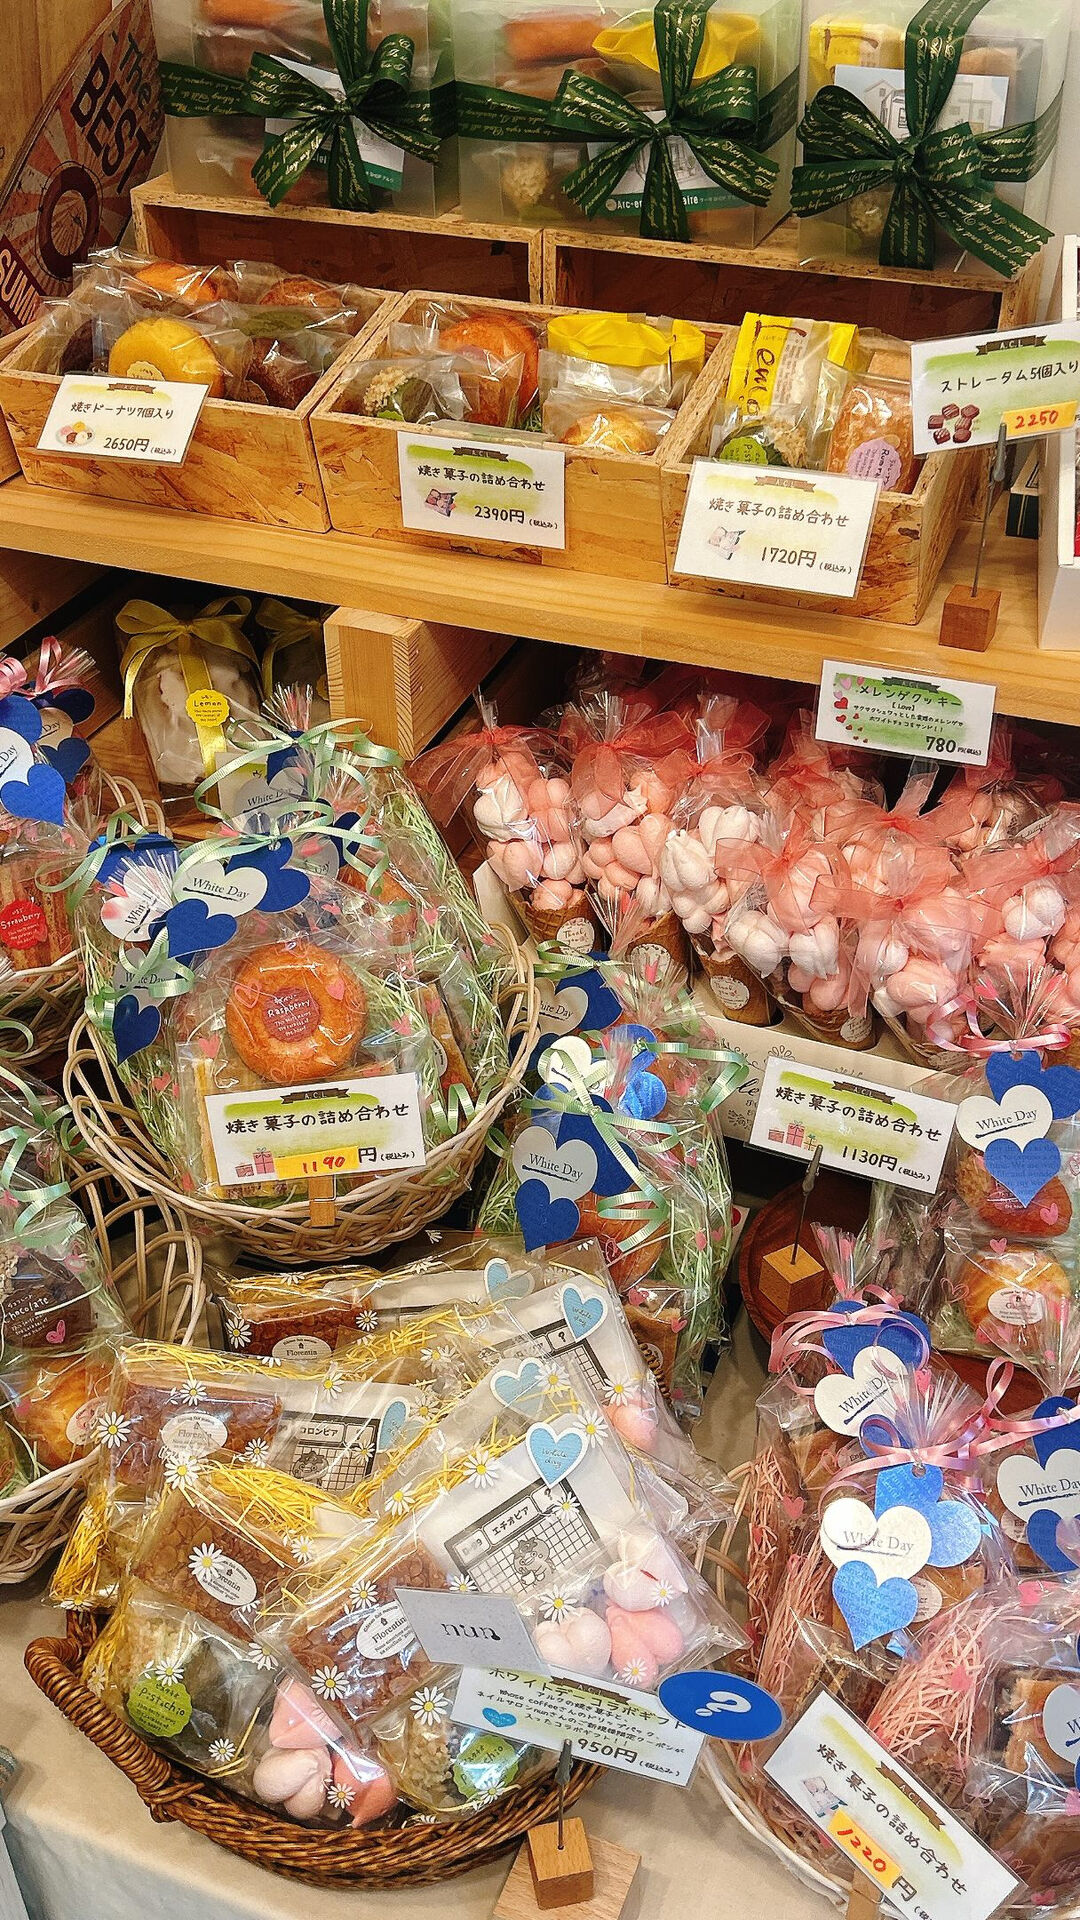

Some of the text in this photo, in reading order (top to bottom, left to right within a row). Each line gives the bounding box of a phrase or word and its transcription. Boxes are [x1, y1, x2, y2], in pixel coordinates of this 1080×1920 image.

[70, 51, 151, 195] BEST
[941, 359, 1080, 394] ストレータム5個入り
[70, 400, 174, 421] 焼きドーナツ7個入り
[1014, 410, 1059, 430] 2250
[103, 437, 150, 453] 2650円
[417, 464, 546, 492] 焼き菓子の詰め合わせ
[474, 505, 525, 525] 2390円
[708, 496, 850, 528] 焼き菓子の詰め合わせ
[760, 546, 818, 569] 1720円
[193, 700, 222, 708] Lemon
[859, 685, 963, 708] メレンゲクッキー
[42, 719, 61, 735] Day
[926, 735, 956, 754] 780
[247, 793, 273, 807] White
[192, 877, 249, 901] White Day
[0, 911, 41, 930] Strawberry
[267, 999, 310, 1018] Raspberry
[555, 1004, 574, 1020] Day
[225, 1103, 409, 1135] 焼き菓子の詰め合わせ
[775, 1086, 943, 1143] 焼き菓子の詰め合わせ
[975, 1108, 1039, 1132] White Day
[302, 1156, 346, 1174] 1190
[358, 1146, 377, 1164] 円
[529, 1152, 583, 1183] White Day
[841, 1145, 898, 1172] 1130円
[1019, 1483, 1058, 1498] White
[491, 1505, 529, 1537] エチオピア
[843, 1529, 914, 1557] White Day
[440, 1622, 502, 1642] nun
[577, 1737, 639, 1764] 950円
[815, 1743, 968, 1896] 焼き菓子の詰め合わせ
[836, 1827, 918, 1902] 1220 円
